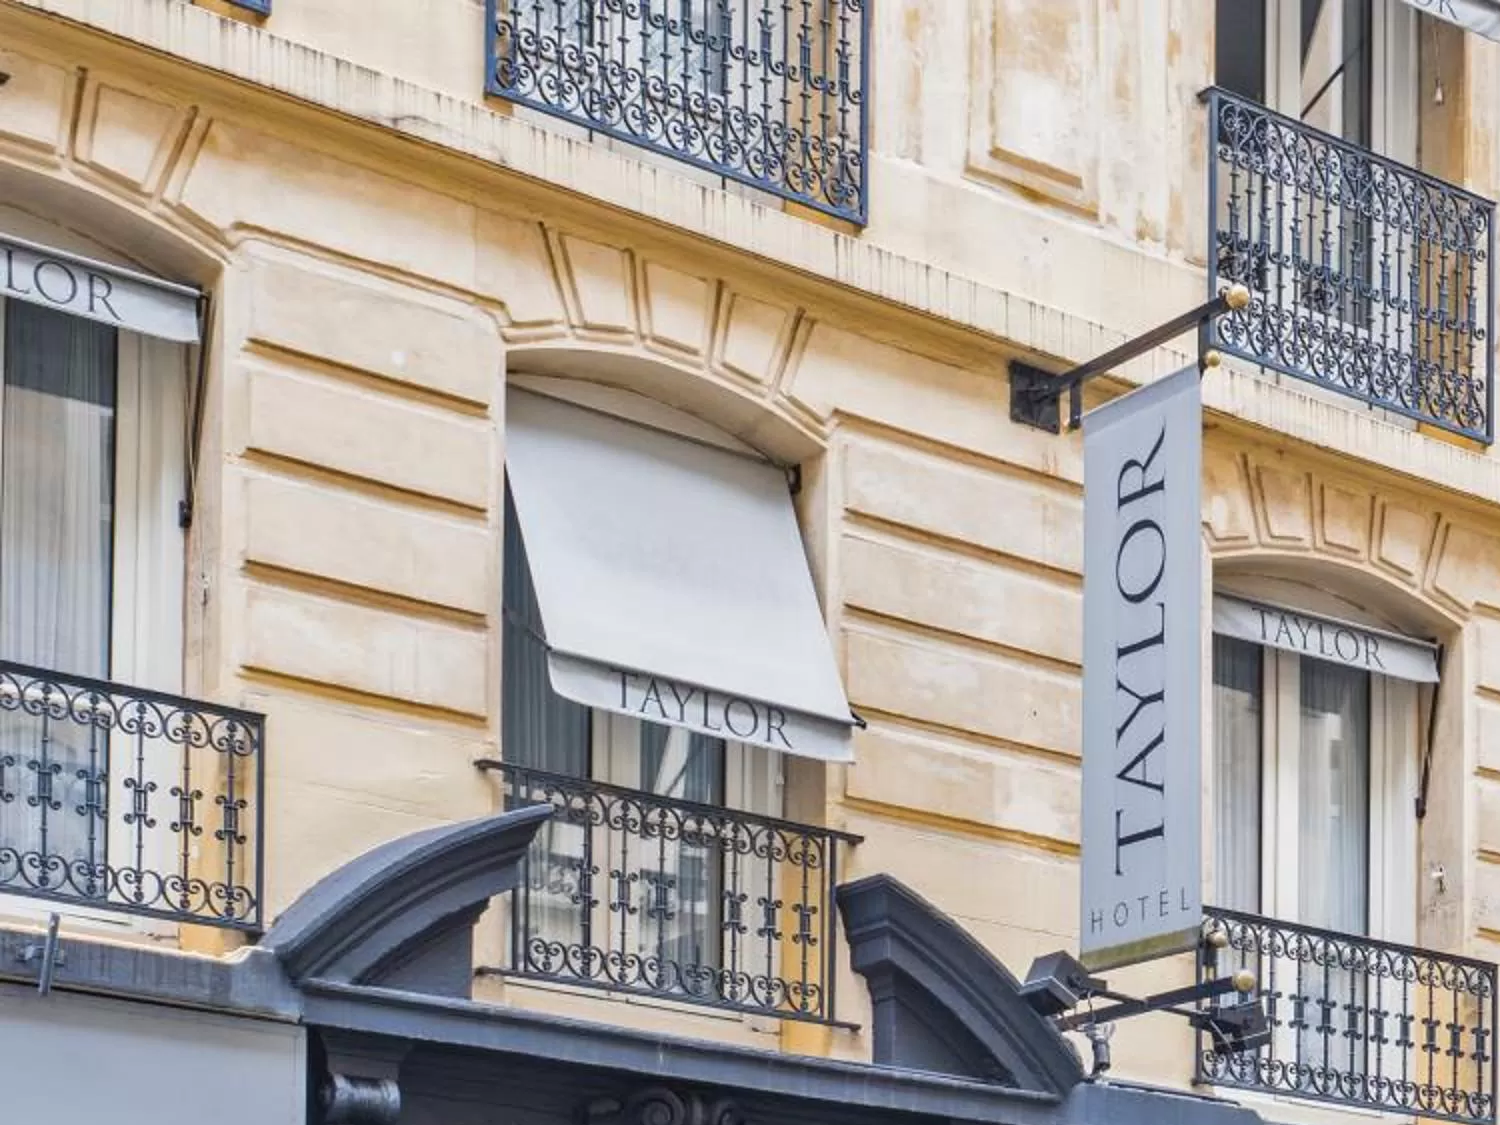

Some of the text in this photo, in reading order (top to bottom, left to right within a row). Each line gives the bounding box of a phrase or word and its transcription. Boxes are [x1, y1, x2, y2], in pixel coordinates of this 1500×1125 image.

[1115, 414, 1167, 877] TAYLOR
[1252, 607, 1387, 670] TAYLOR
[609, 667, 794, 749] TAYLOR
[1090, 886, 1190, 935] HOTEL
